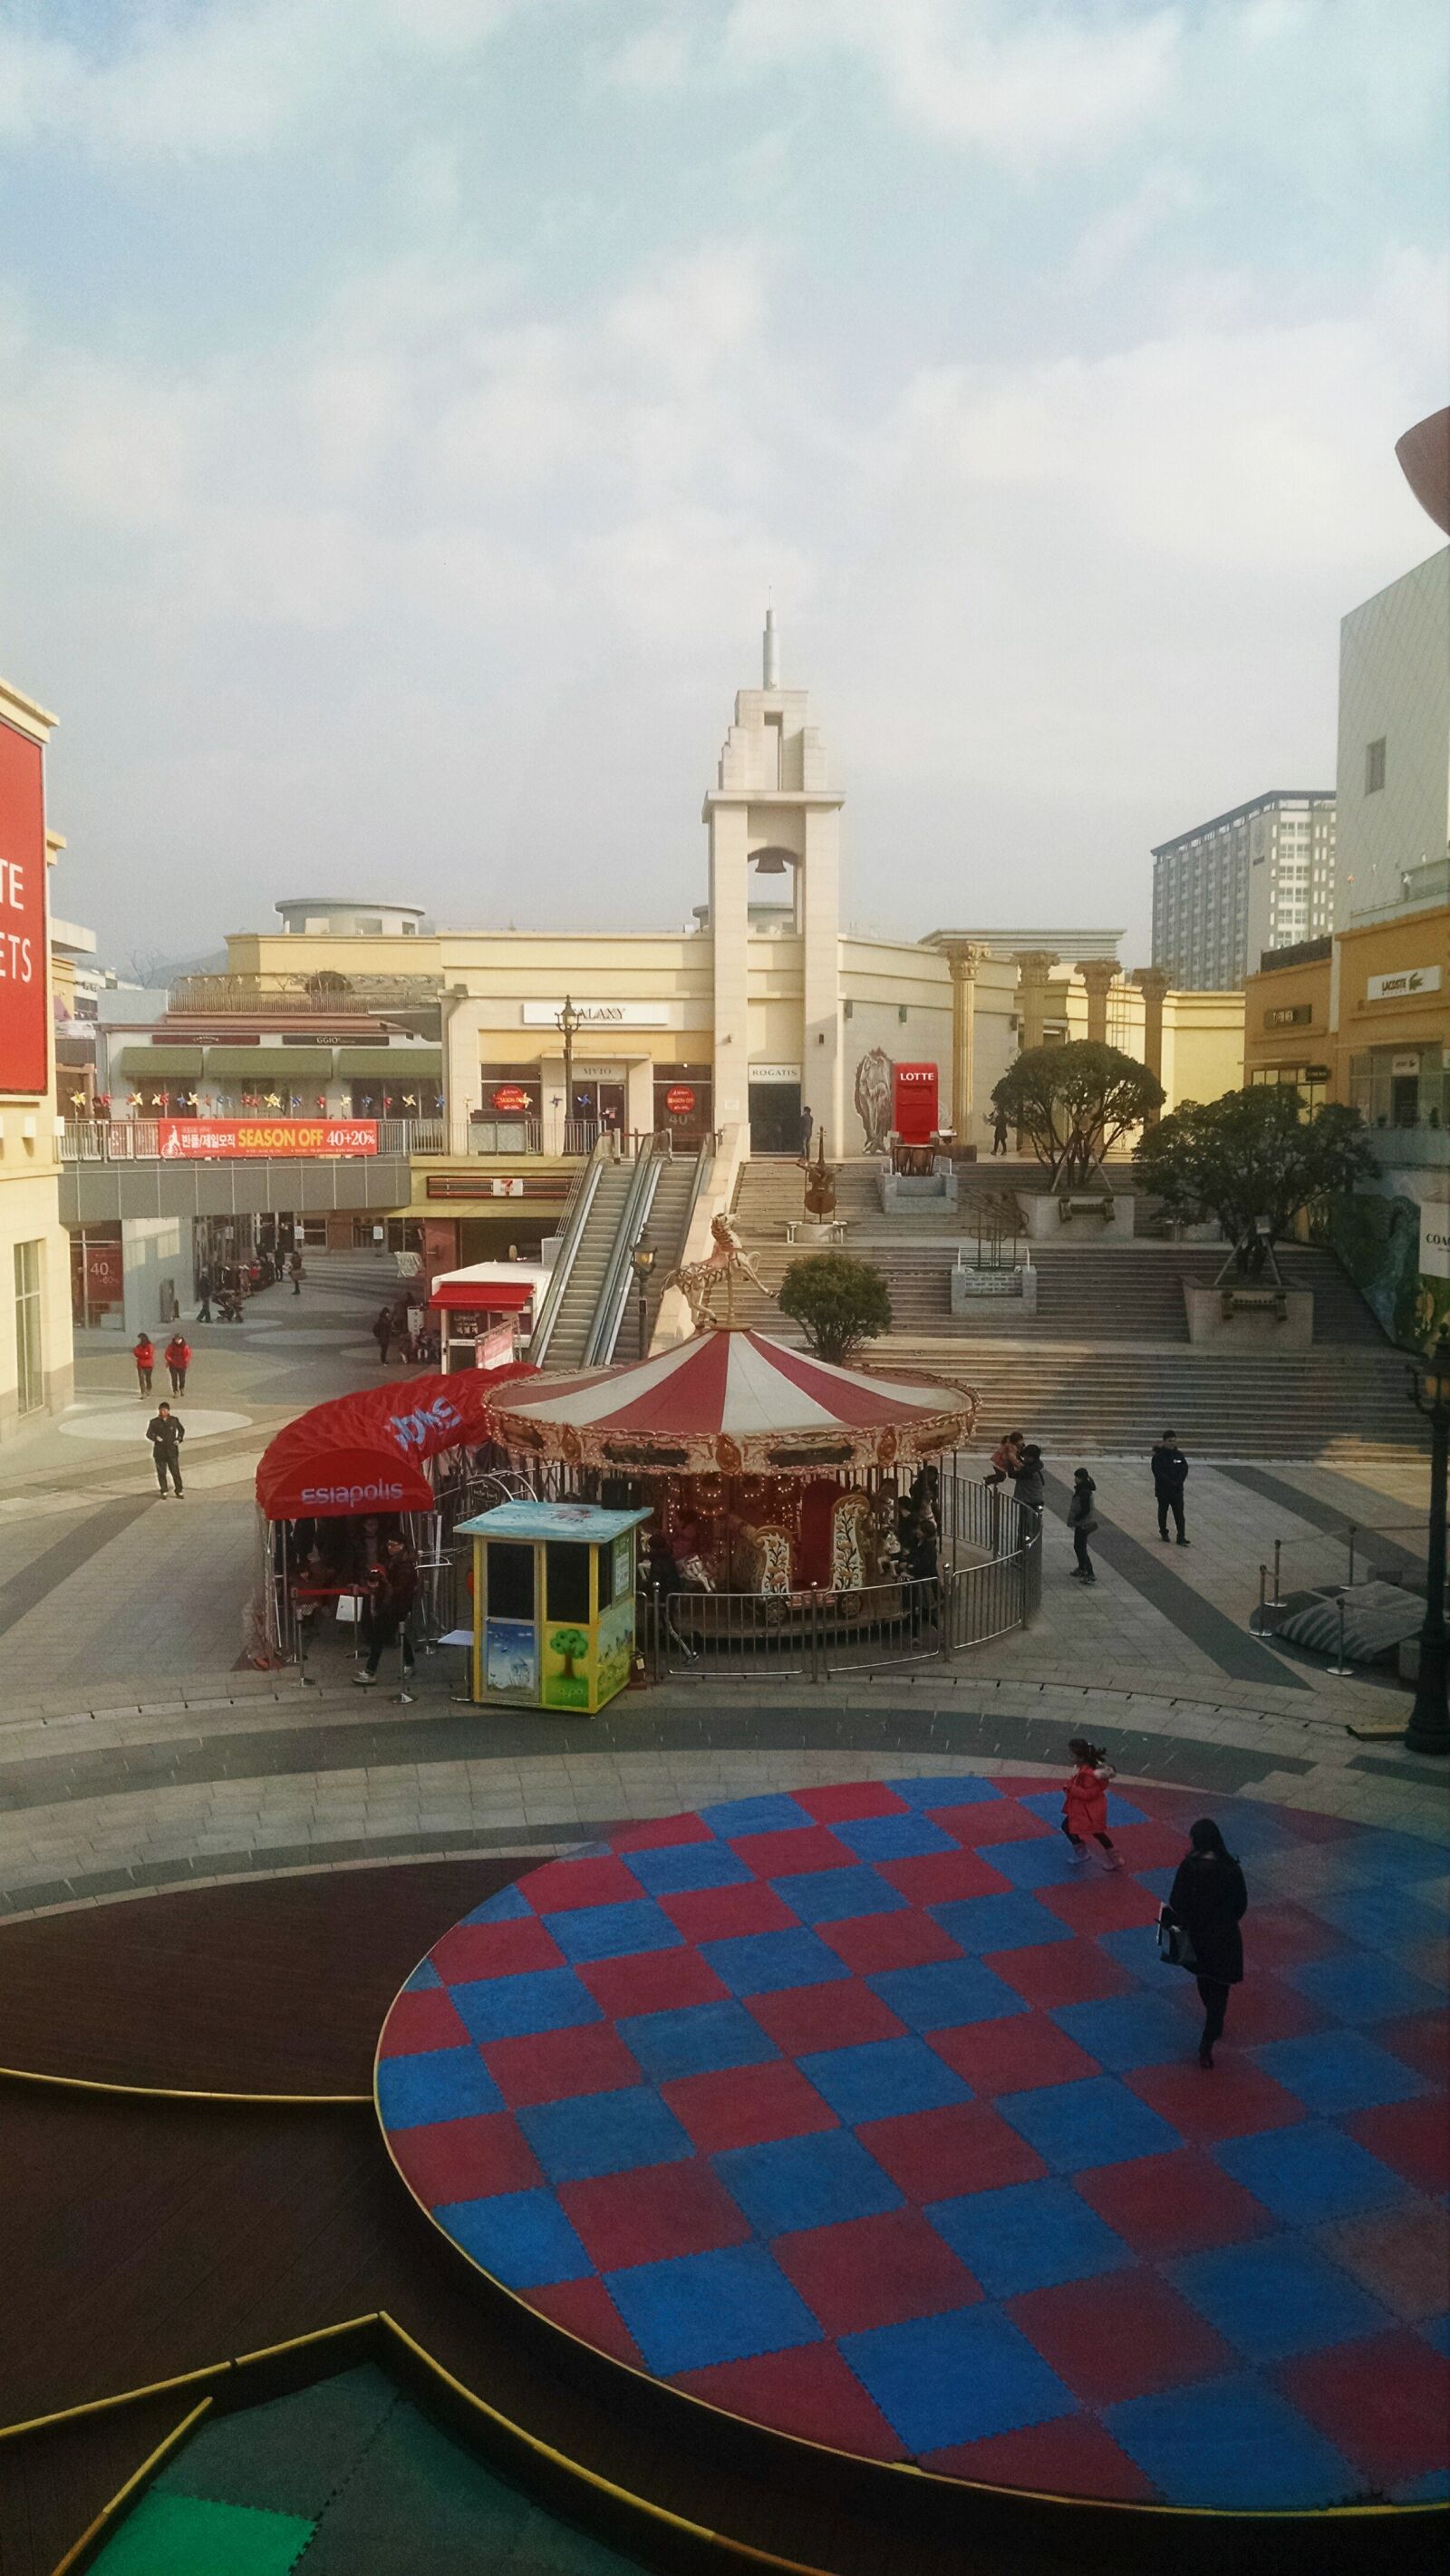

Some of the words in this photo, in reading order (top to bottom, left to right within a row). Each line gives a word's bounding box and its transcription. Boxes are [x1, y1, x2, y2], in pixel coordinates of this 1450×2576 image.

[1381, 978, 1407, 992] LACOSTE
[575, 1008, 625, 1020] ALAXY
[752, 1069, 798, 1077] ROGATIS
[900, 1072, 935, 1081] LOTTE
[237, 1128, 295, 1148] SEASON
[298, 1128, 324, 1147] OFF
[326, 1130, 376, 1147] 40+20%
